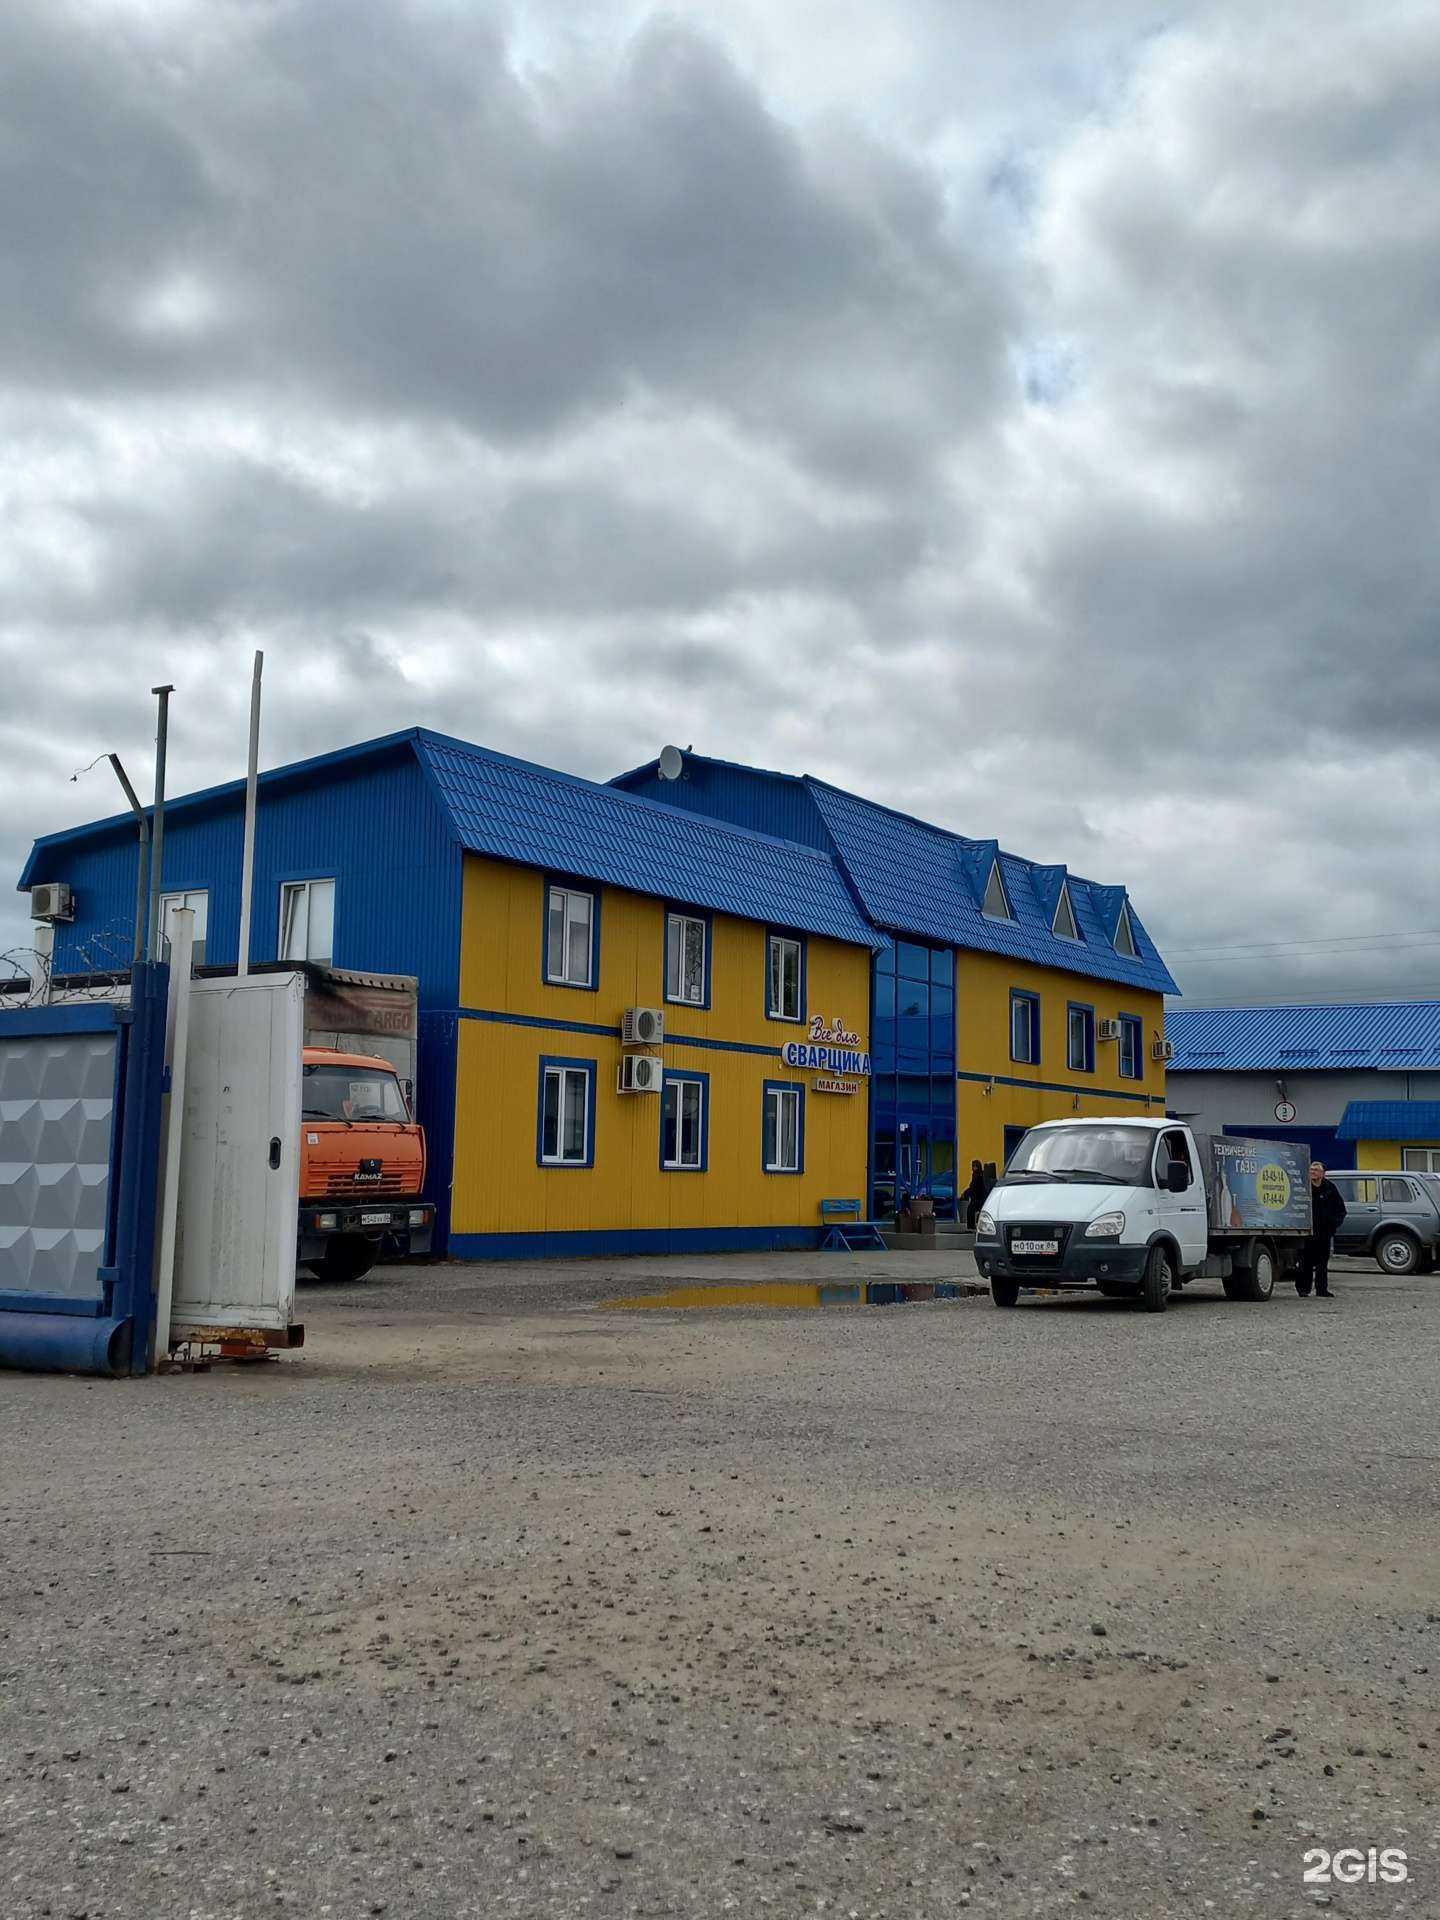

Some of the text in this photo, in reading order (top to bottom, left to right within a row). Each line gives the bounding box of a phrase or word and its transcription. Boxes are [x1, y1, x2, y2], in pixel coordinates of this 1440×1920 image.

[810, 1015, 861, 1045] Все для
[786, 1042, 871, 1076] СВАРЩИКА
[818, 1080, 857, 1093] МАГАЗИН
[1235, 1159, 1257, 1175] ГАЗЫ
